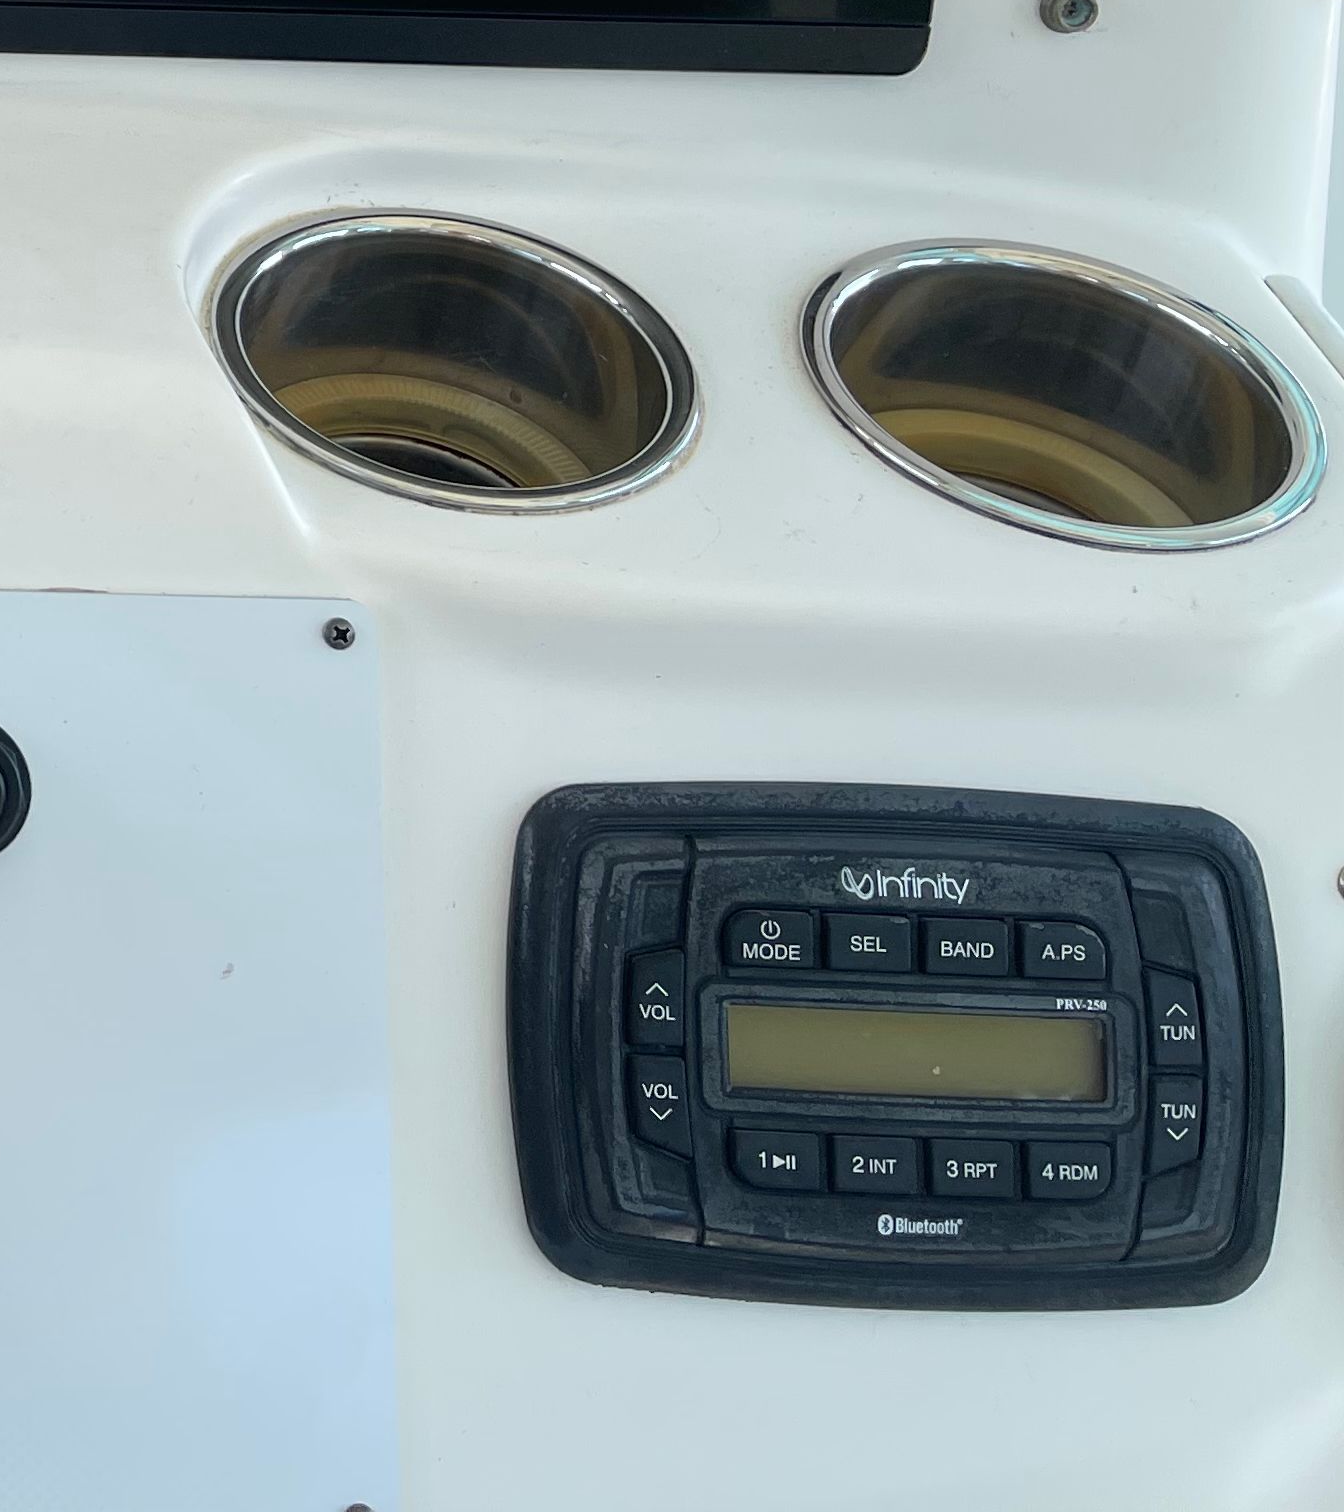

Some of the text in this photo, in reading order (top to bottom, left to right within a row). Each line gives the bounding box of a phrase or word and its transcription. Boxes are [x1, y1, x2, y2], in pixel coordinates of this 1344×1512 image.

[877, 867, 969, 904] Infinity
[742, 943, 801, 963] MODE
[850, 935, 887, 954] SEL
[939, 940, 995, 960] BAND
[638, 1004, 676, 1022] VOL
[1056, 997, 1107, 1013] PRV-250
[1159, 1024, 1196, 1042] TUN
[641, 1082, 678, 1100] VOL
[1160, 1103, 1197, 1120] TUN
[851, 1156, 898, 1176] 2 INT
[946, 1159, 998, 1180] 3 RPT
[1042, 1163, 1099, 1182] 4 RDM
